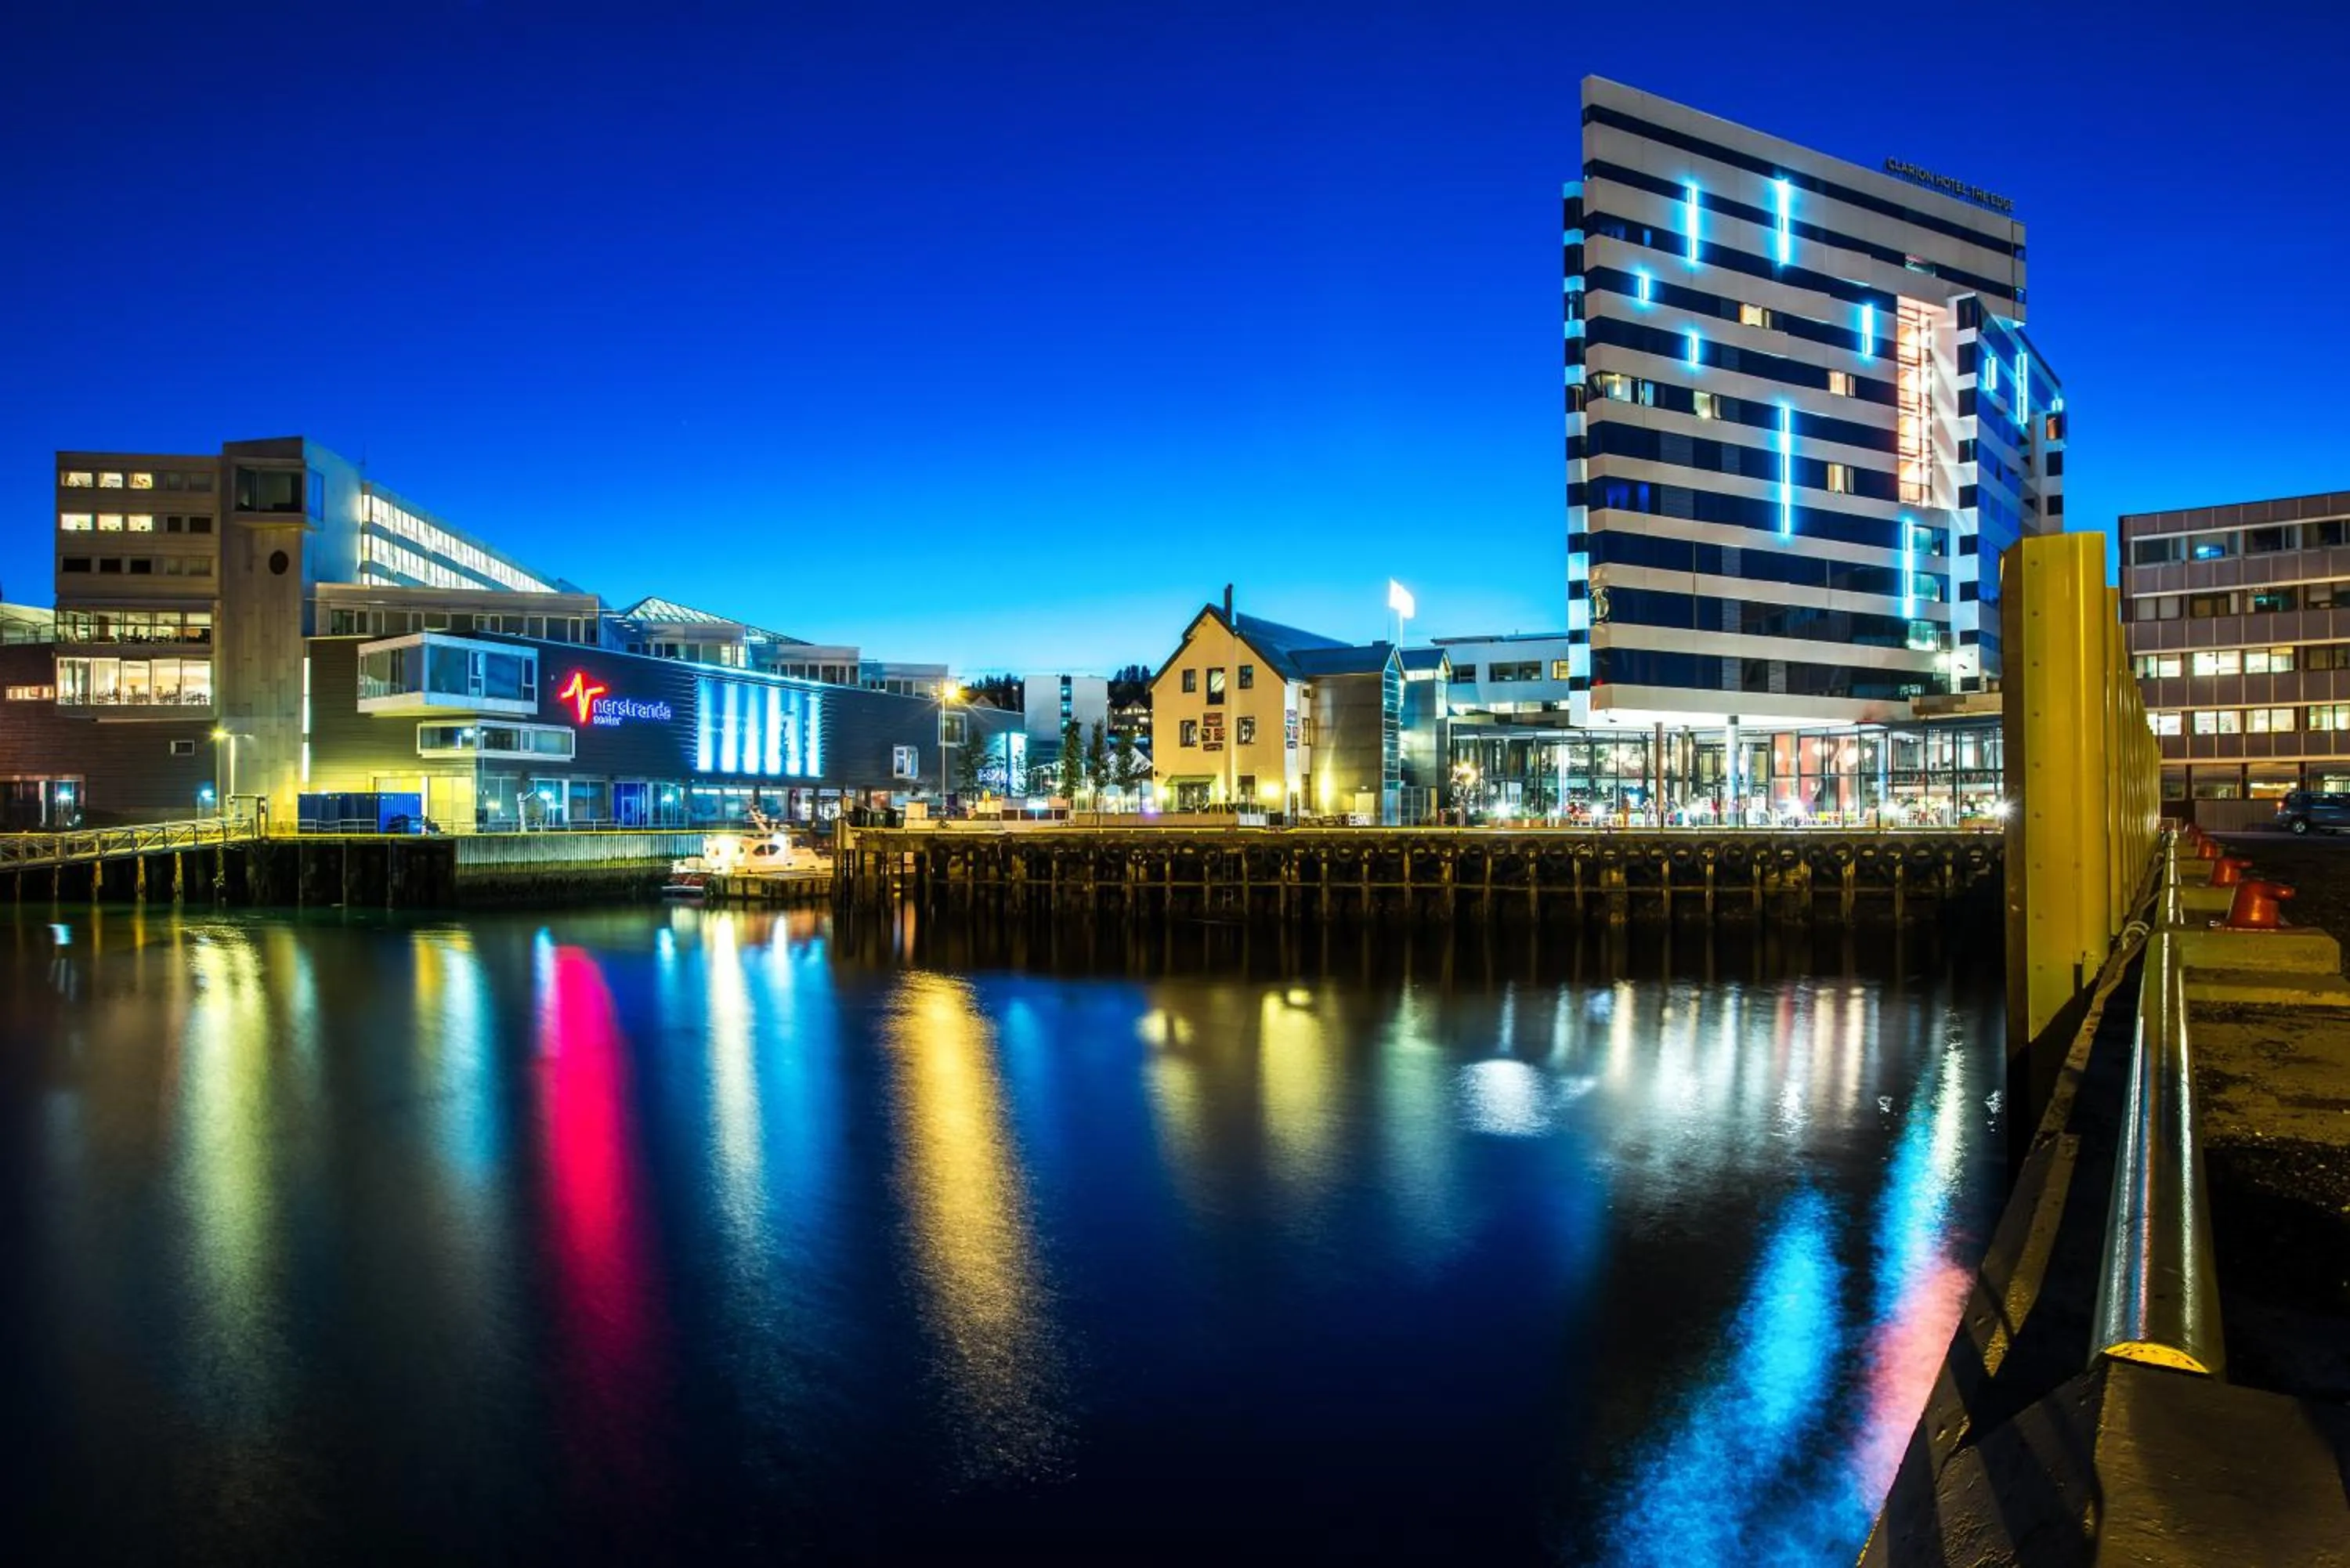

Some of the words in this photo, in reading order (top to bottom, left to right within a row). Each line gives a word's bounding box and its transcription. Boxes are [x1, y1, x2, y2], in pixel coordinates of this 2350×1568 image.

[1885, 157, 1935, 183] CLARION
[1936, 173, 1966, 193] HOTEL
[1972, 185, 1990, 201] THE
[1990, 193, 2014, 211] EDGE
[593, 699, 671, 719] nerstranda
